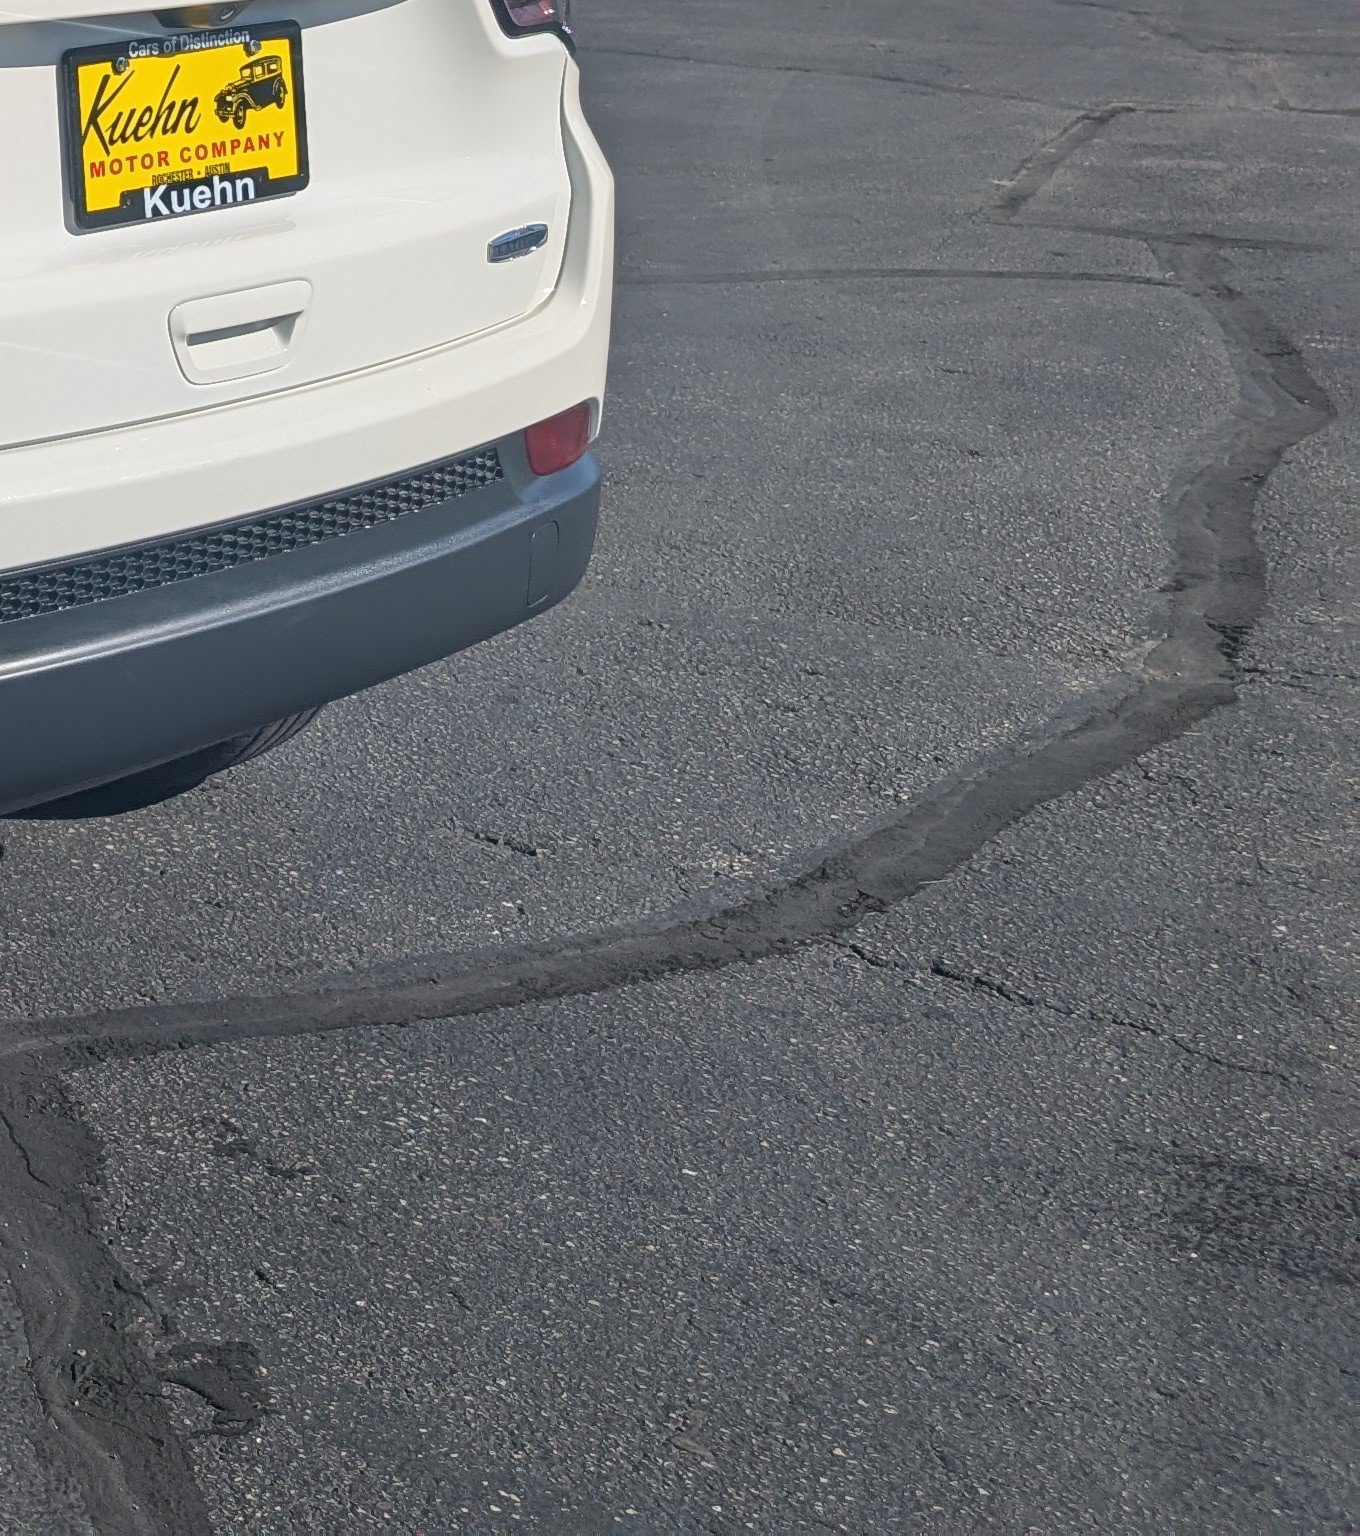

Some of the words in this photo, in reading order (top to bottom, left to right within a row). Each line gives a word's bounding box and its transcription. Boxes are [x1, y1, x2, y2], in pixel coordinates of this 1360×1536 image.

[128, 41, 159, 58] Cars
[163, 35, 178, 53] of
[180, 28, 249, 51] Distinction
[82, 64, 201, 157] Kuehn
[90, 151, 170, 178] MOTOR
[180, 131, 285, 163] COMPANY
[152, 168, 194, 186] ROCHESTER
[205, 162, 231, 177] AUSTIN
[143, 175, 255, 218] Kuehn
